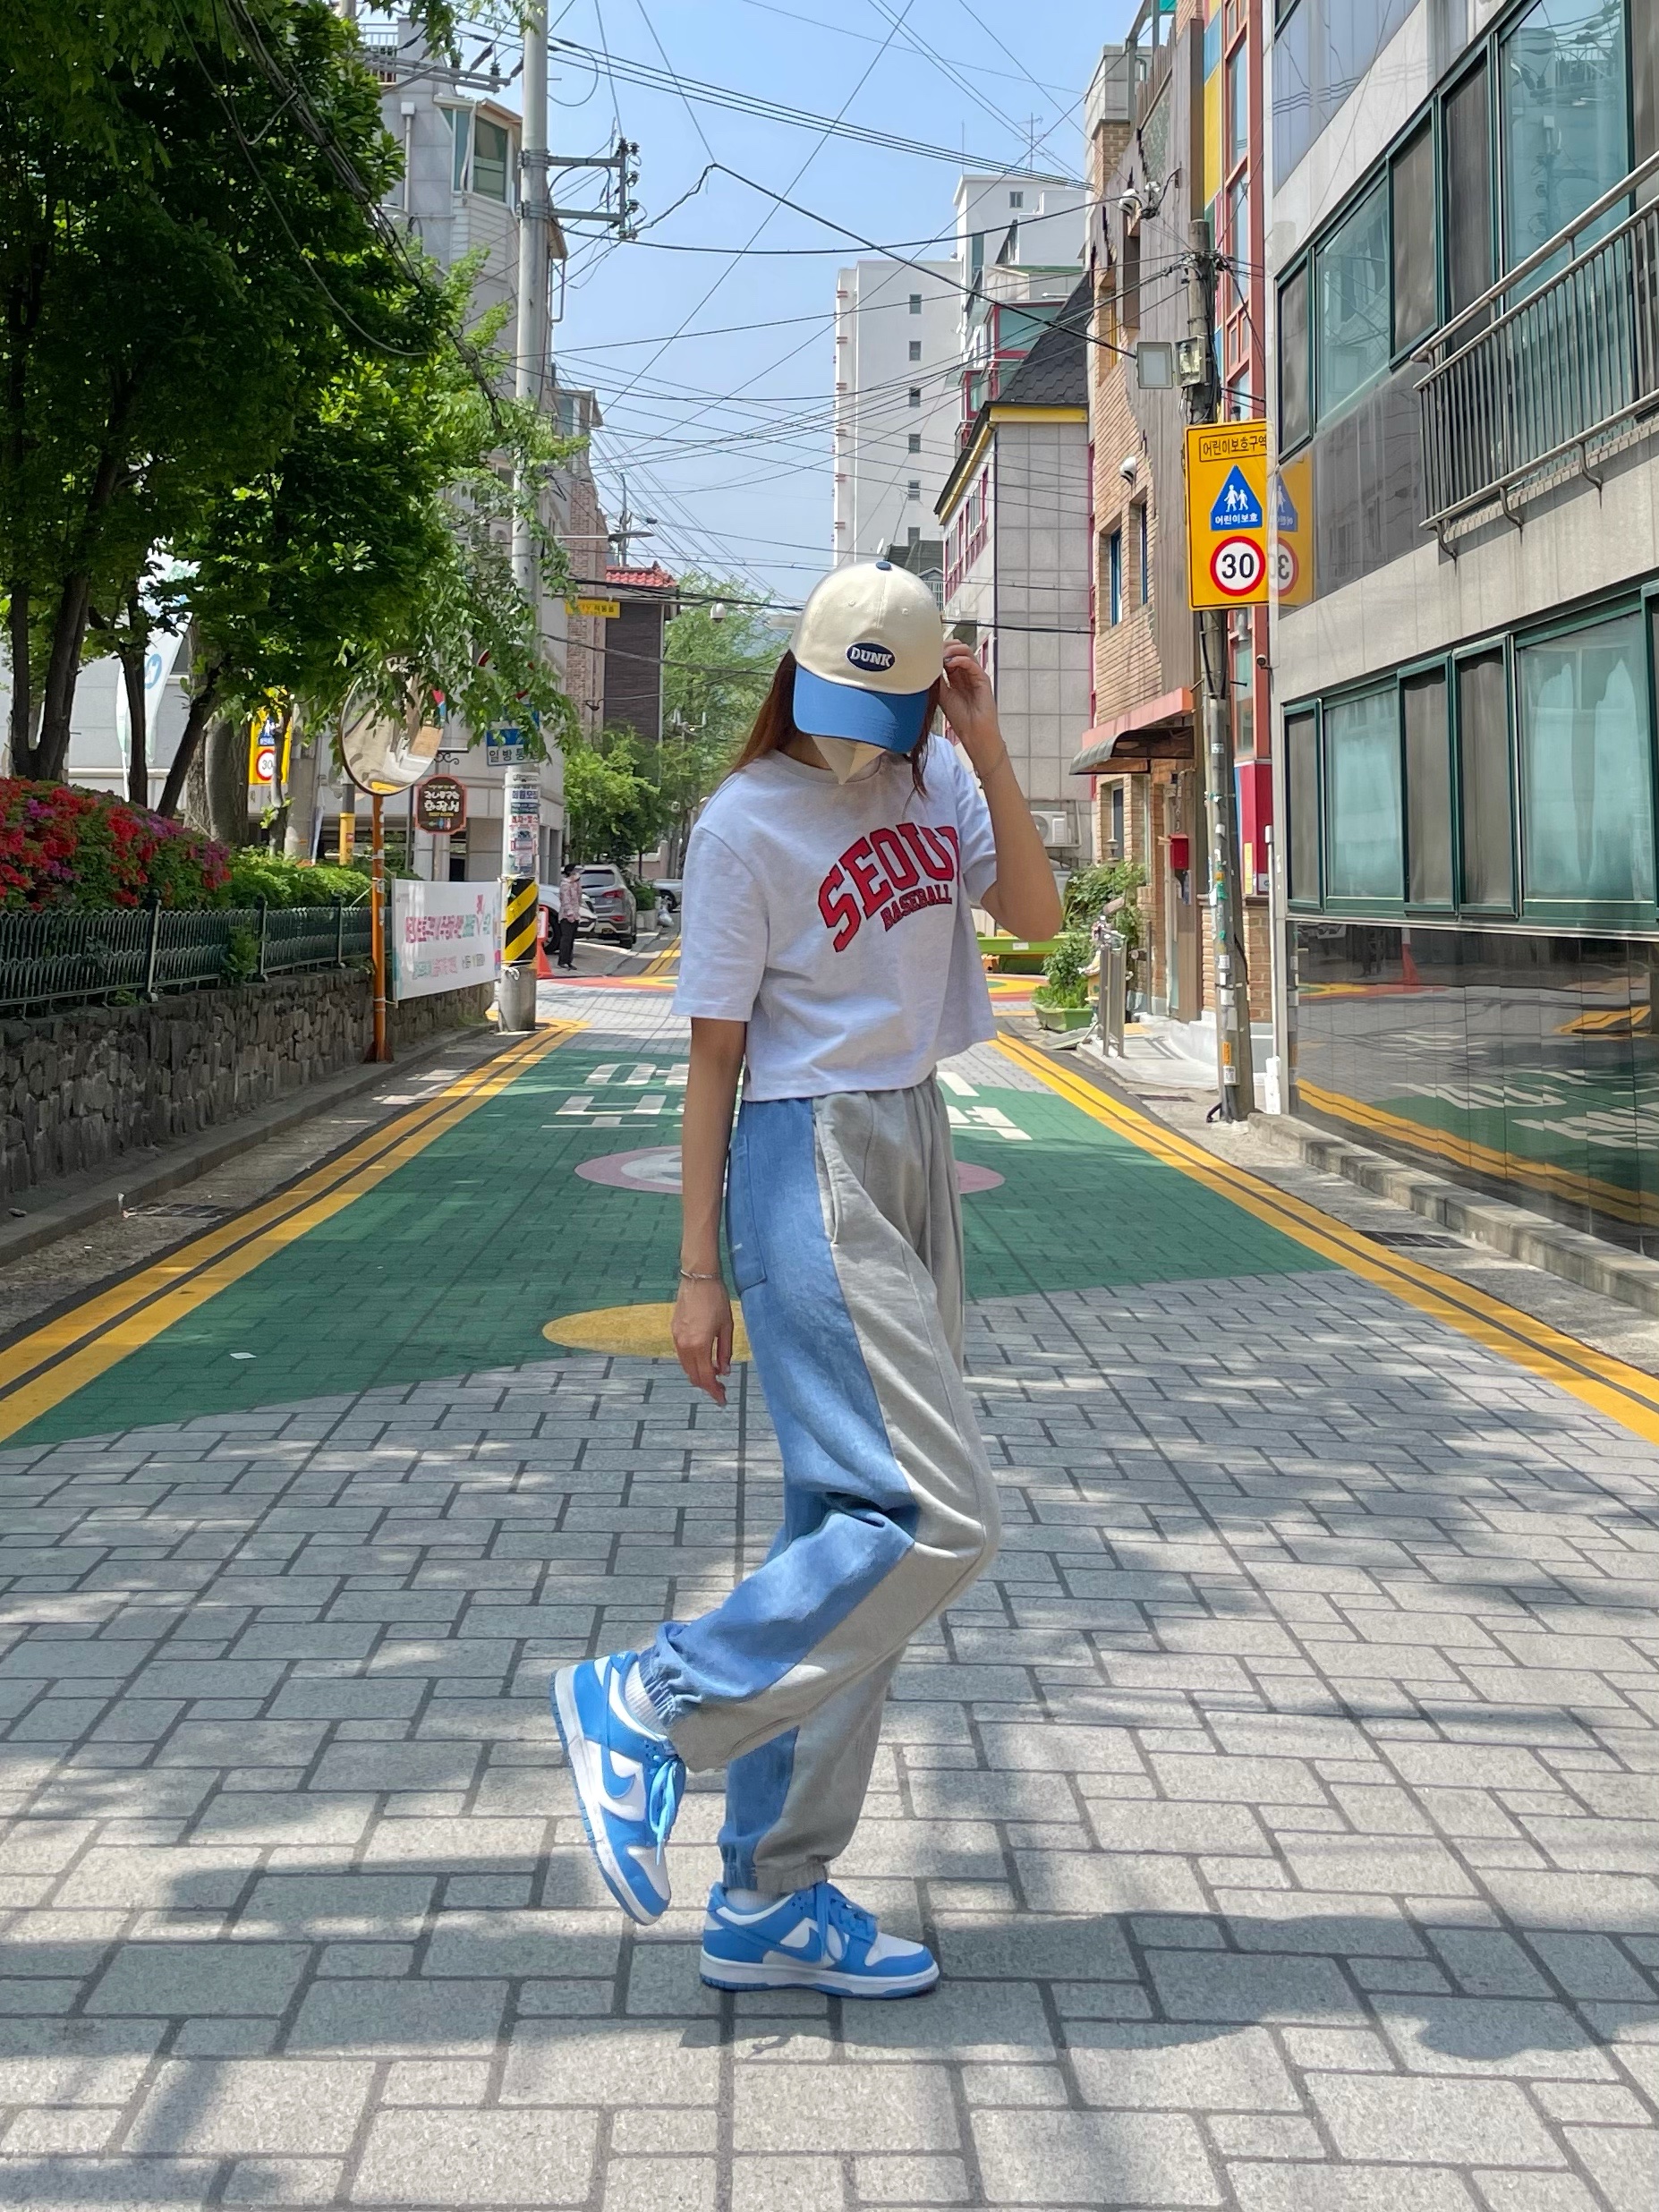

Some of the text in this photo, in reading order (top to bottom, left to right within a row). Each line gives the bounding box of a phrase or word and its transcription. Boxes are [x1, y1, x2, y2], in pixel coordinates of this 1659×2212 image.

[1214, 512, 1258, 525] 어린이보호
[1221, 553, 1255, 579] 30
[849, 646, 893, 668] DUNK
[489, 746, 540, 763] 일방통
[880, 883, 953, 932] BASEBALL
